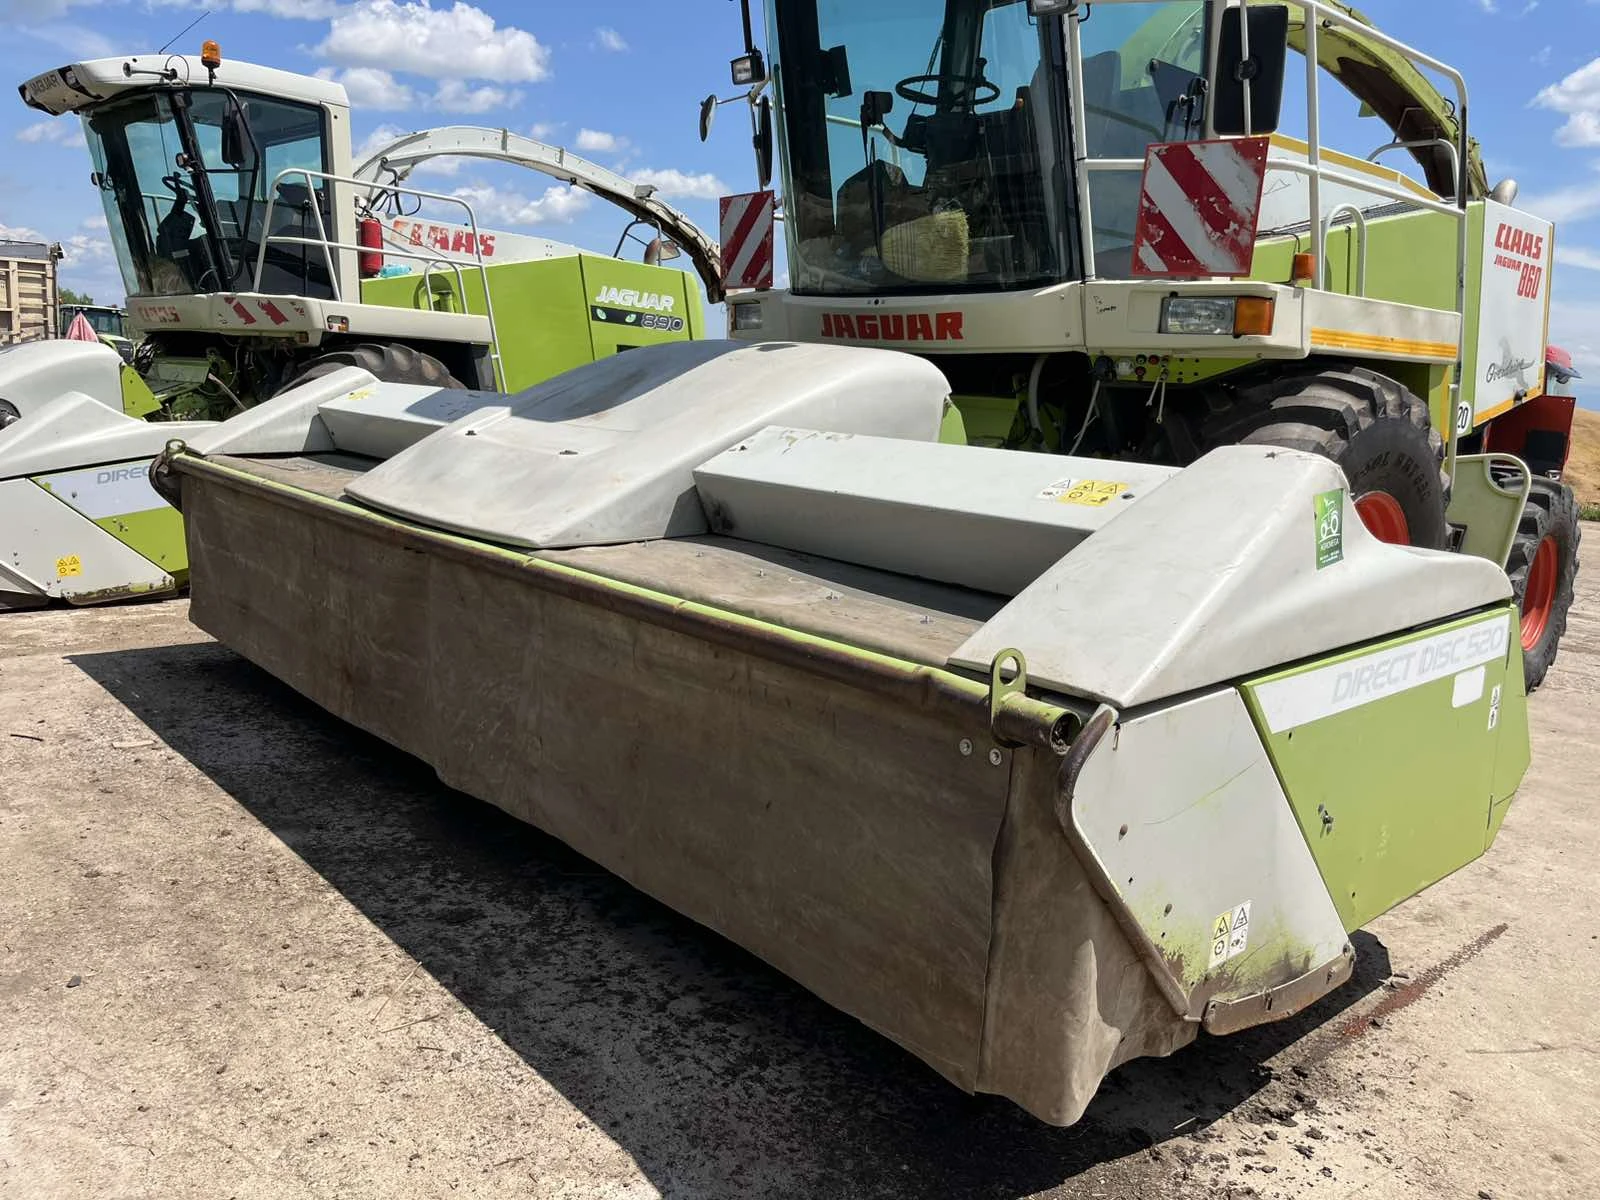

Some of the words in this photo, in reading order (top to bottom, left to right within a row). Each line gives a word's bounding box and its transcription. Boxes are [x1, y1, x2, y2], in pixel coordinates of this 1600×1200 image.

[1495, 223, 1543, 260] CLAAS
[1494, 254, 1521, 272] JAGUAR
[1517, 263, 1542, 299] 860
[595, 286, 675, 312] JAGUAR
[641, 313, 684, 332] 890
[821, 312, 964, 340] JAGUAR
[97, 465, 149, 485] DIREC
[1332, 651, 1417, 704] DIRECT
[1417, 636, 1462, 676] DISC
[1464, 626, 1504, 657] 520
